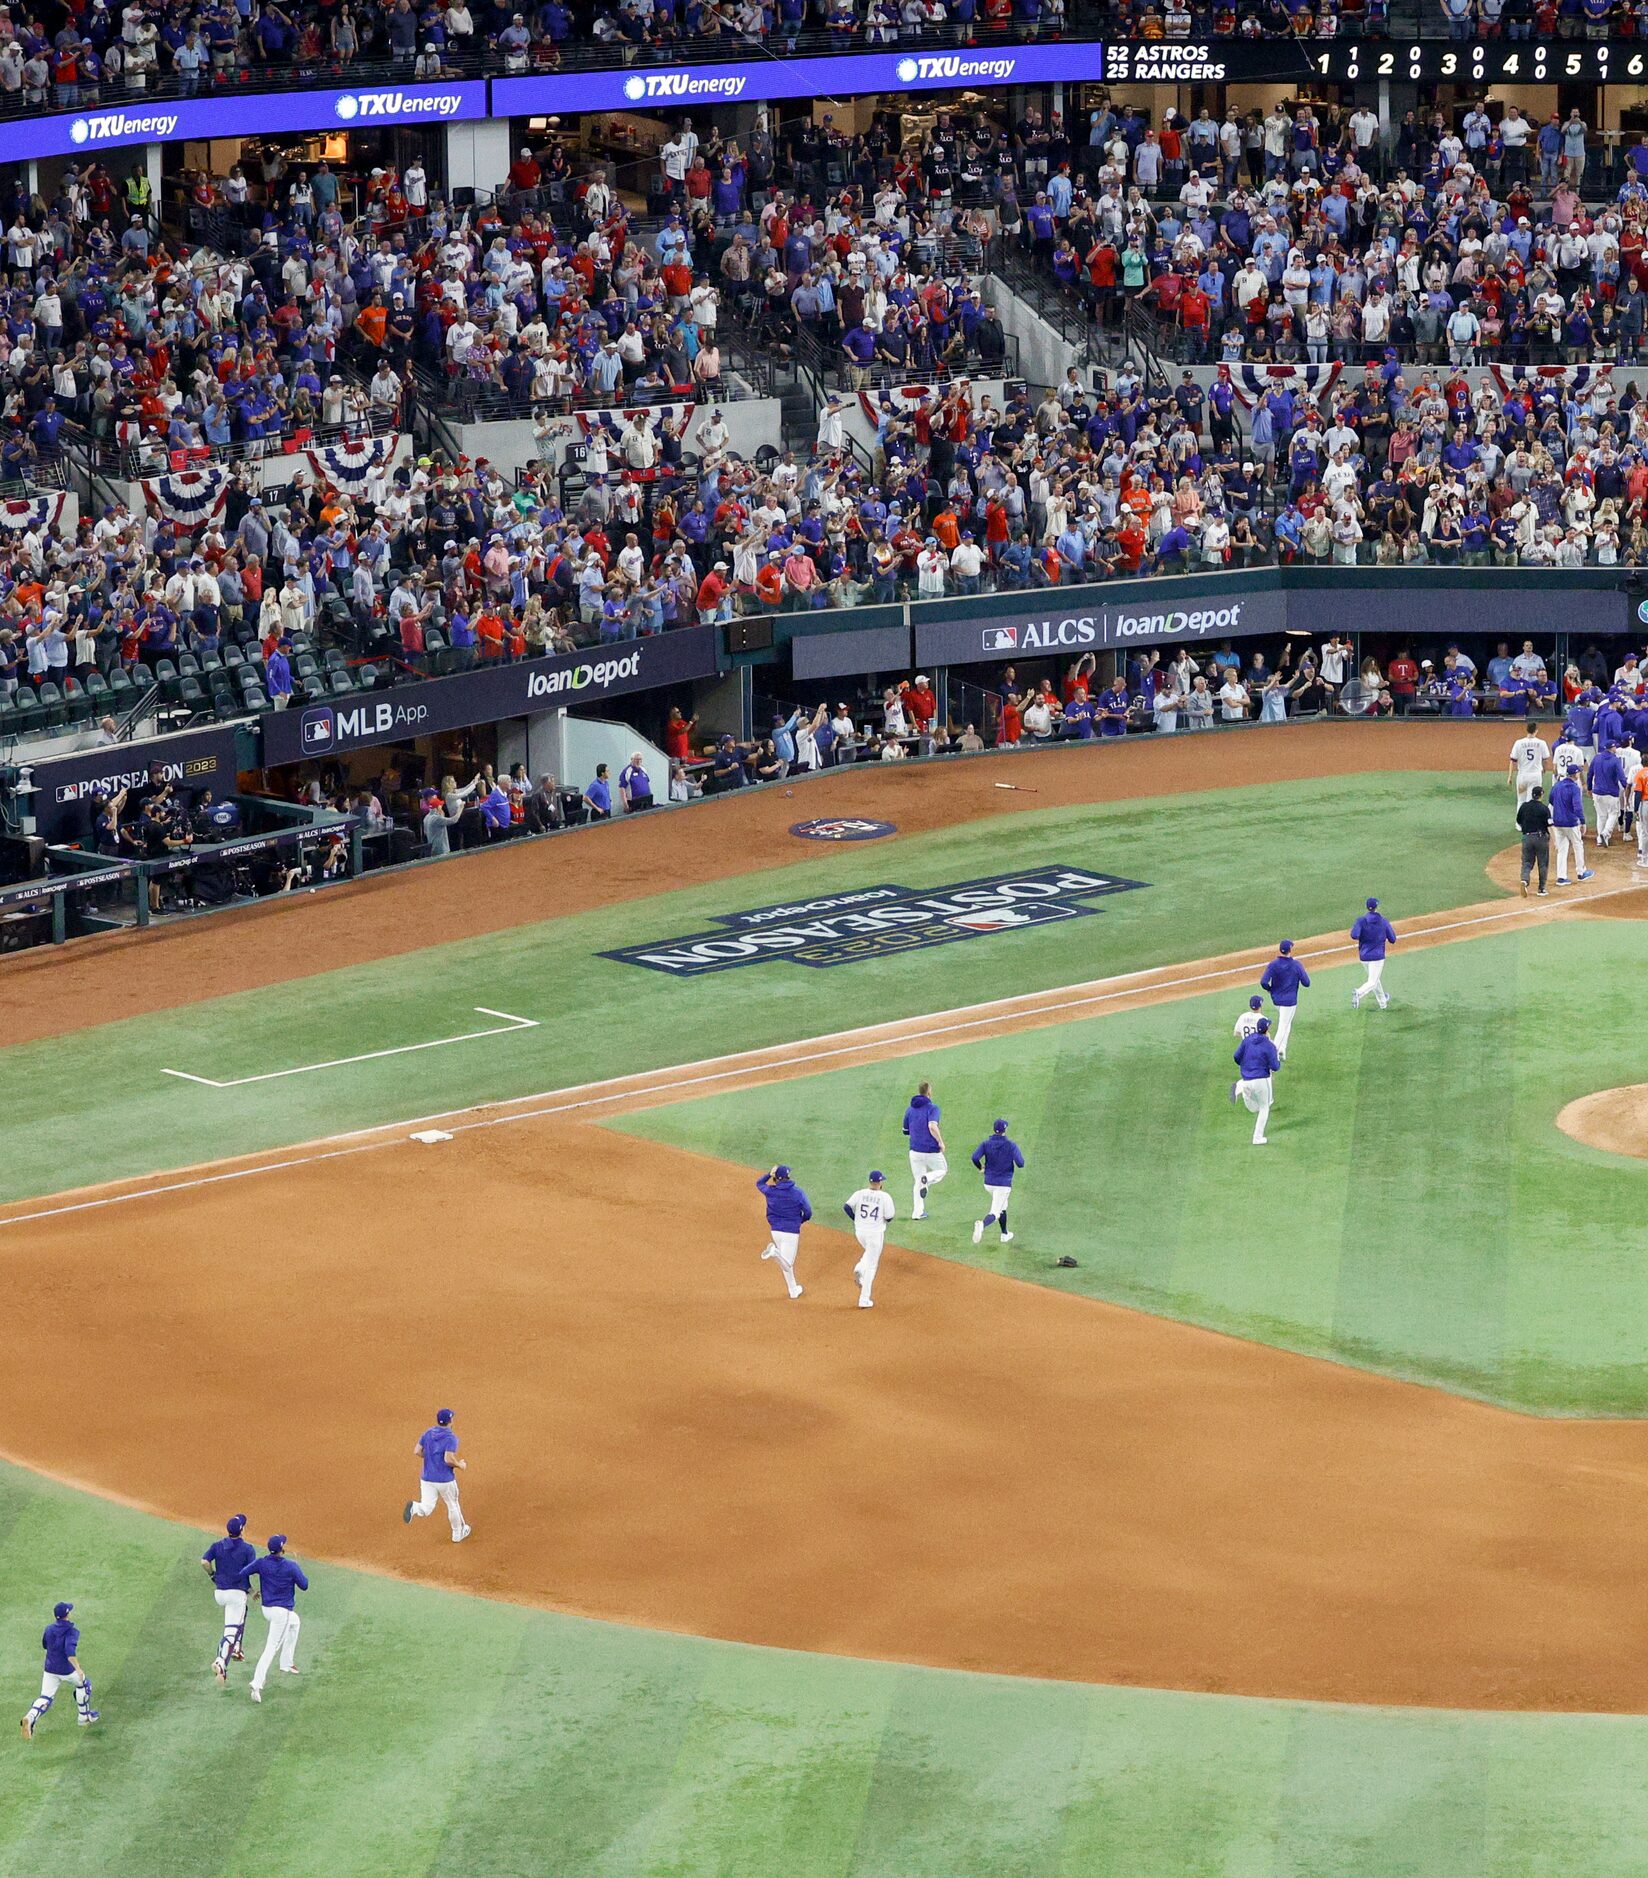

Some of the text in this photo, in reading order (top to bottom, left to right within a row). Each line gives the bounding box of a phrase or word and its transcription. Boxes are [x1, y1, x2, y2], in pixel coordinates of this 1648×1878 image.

[1107, 46, 1208, 61] 52 ASTROS
[1350, 47, 1357, 60] 1
[1410, 47, 1420, 60] 0
[1473, 47, 1483, 60] 0
[1535, 47, 1546, 60] 0
[1598, 47, 1608, 61] 0
[1318, 54, 1329, 73] 1
[1378, 54, 1393, 73] 2
[1441, 54, 1456, 74] 3
[1503, 55, 1518, 74] 4
[1566, 55, 1581, 74] 5
[1628, 55, 1643, 74] 6
[1107, 64, 1225, 79] 25 RANGERS
[1348, 65, 1358, 78] 0
[1410, 65, 1420, 78] 0
[1473, 65, 1483, 78] 0
[1535, 65, 1546, 78] 0
[1600, 65, 1607, 78] 1
[1457, 411, 1466, 422] T
[574, 446, 586, 459] 16
[269, 490, 279, 503] 17
[1022, 603, 1240, 648] ALCS loanDepot
[527, 650, 640, 698] loanDepot
[1398, 664, 1408, 676] T
[336, 704, 428, 740] MLB App
[1527, 749, 1534, 761] 5
[1560, 755, 1573, 767] 32
[78, 759, 216, 799] POSTSEAON 2023
[228, 841, 266, 856] POSTSEASON
[84, 872, 120, 886] POSTSEASON
[743, 888, 898, 923] loanDepot
[636, 872, 1110, 968] POSTSEASON
[794, 924, 961, 961] 2023
[860, 1204, 879, 1221] 54
